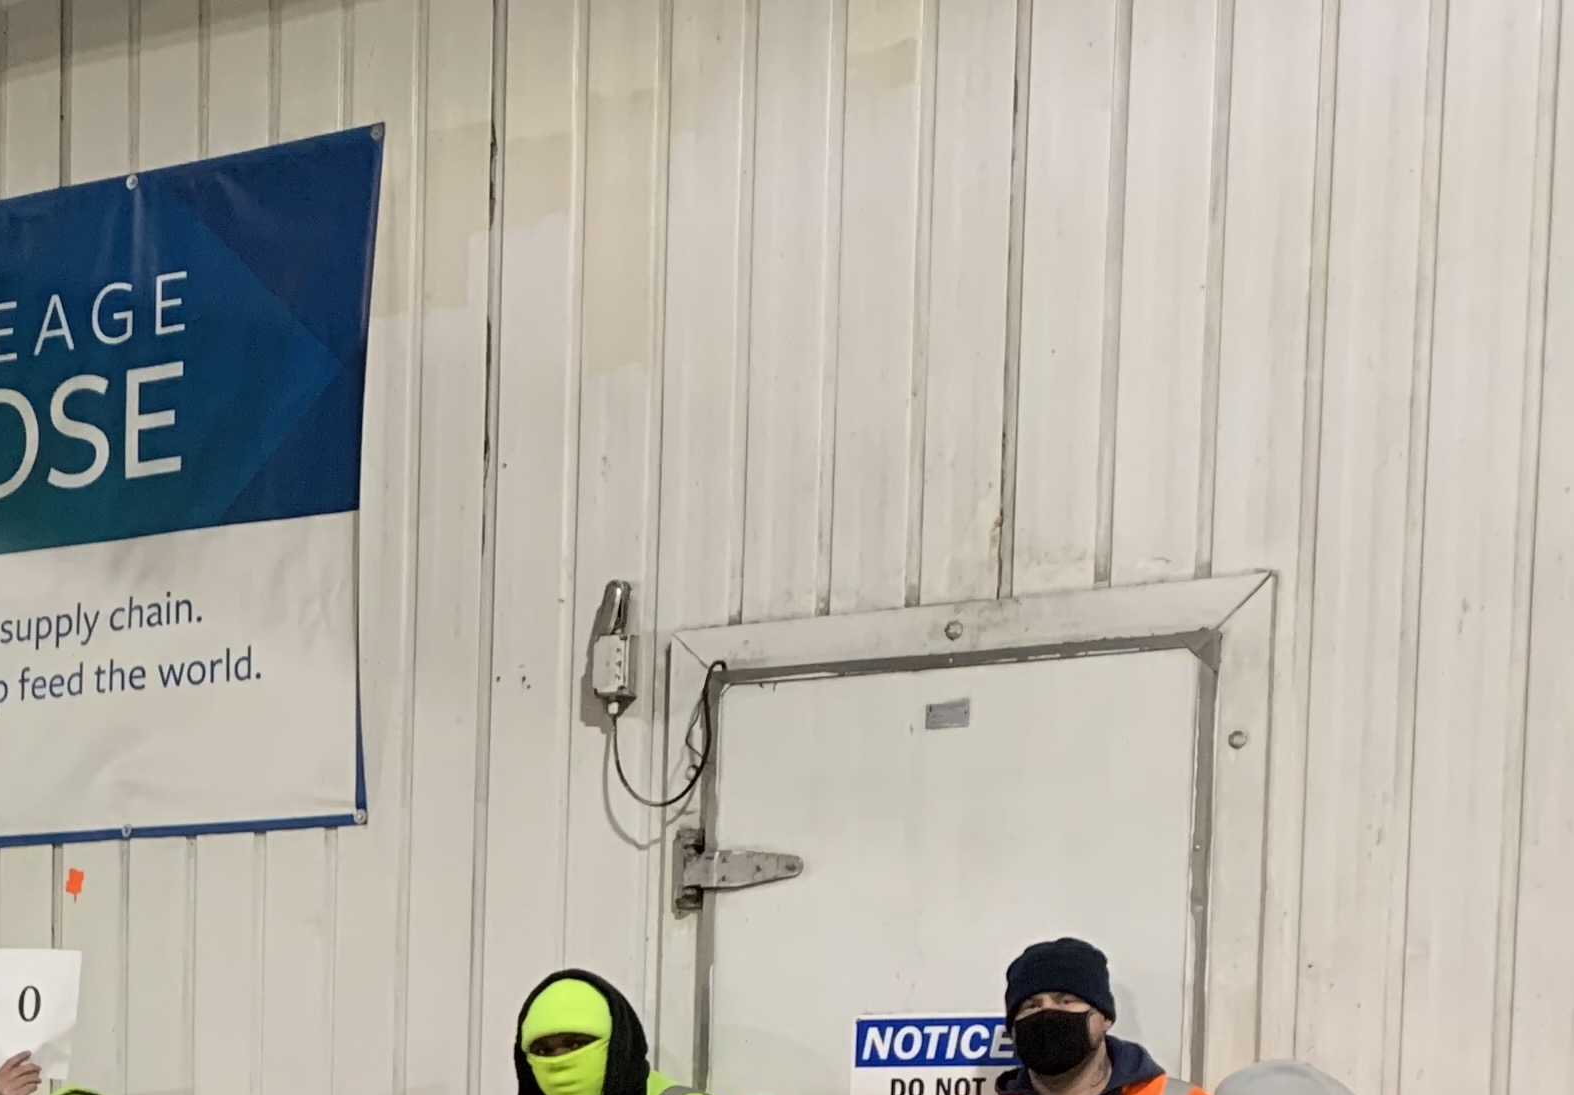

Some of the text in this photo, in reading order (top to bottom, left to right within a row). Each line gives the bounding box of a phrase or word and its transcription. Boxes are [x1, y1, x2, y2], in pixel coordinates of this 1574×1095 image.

[0, 602, 100, 650] supply
[109, 591, 203, 632] chain.
[18, 662, 84, 701] feed
[94, 658, 147, 694] the
[158, 645, 262, 688] world.
[17, 985, 42, 1023] 0
[862, 1024, 1016, 1060] NOTICE
